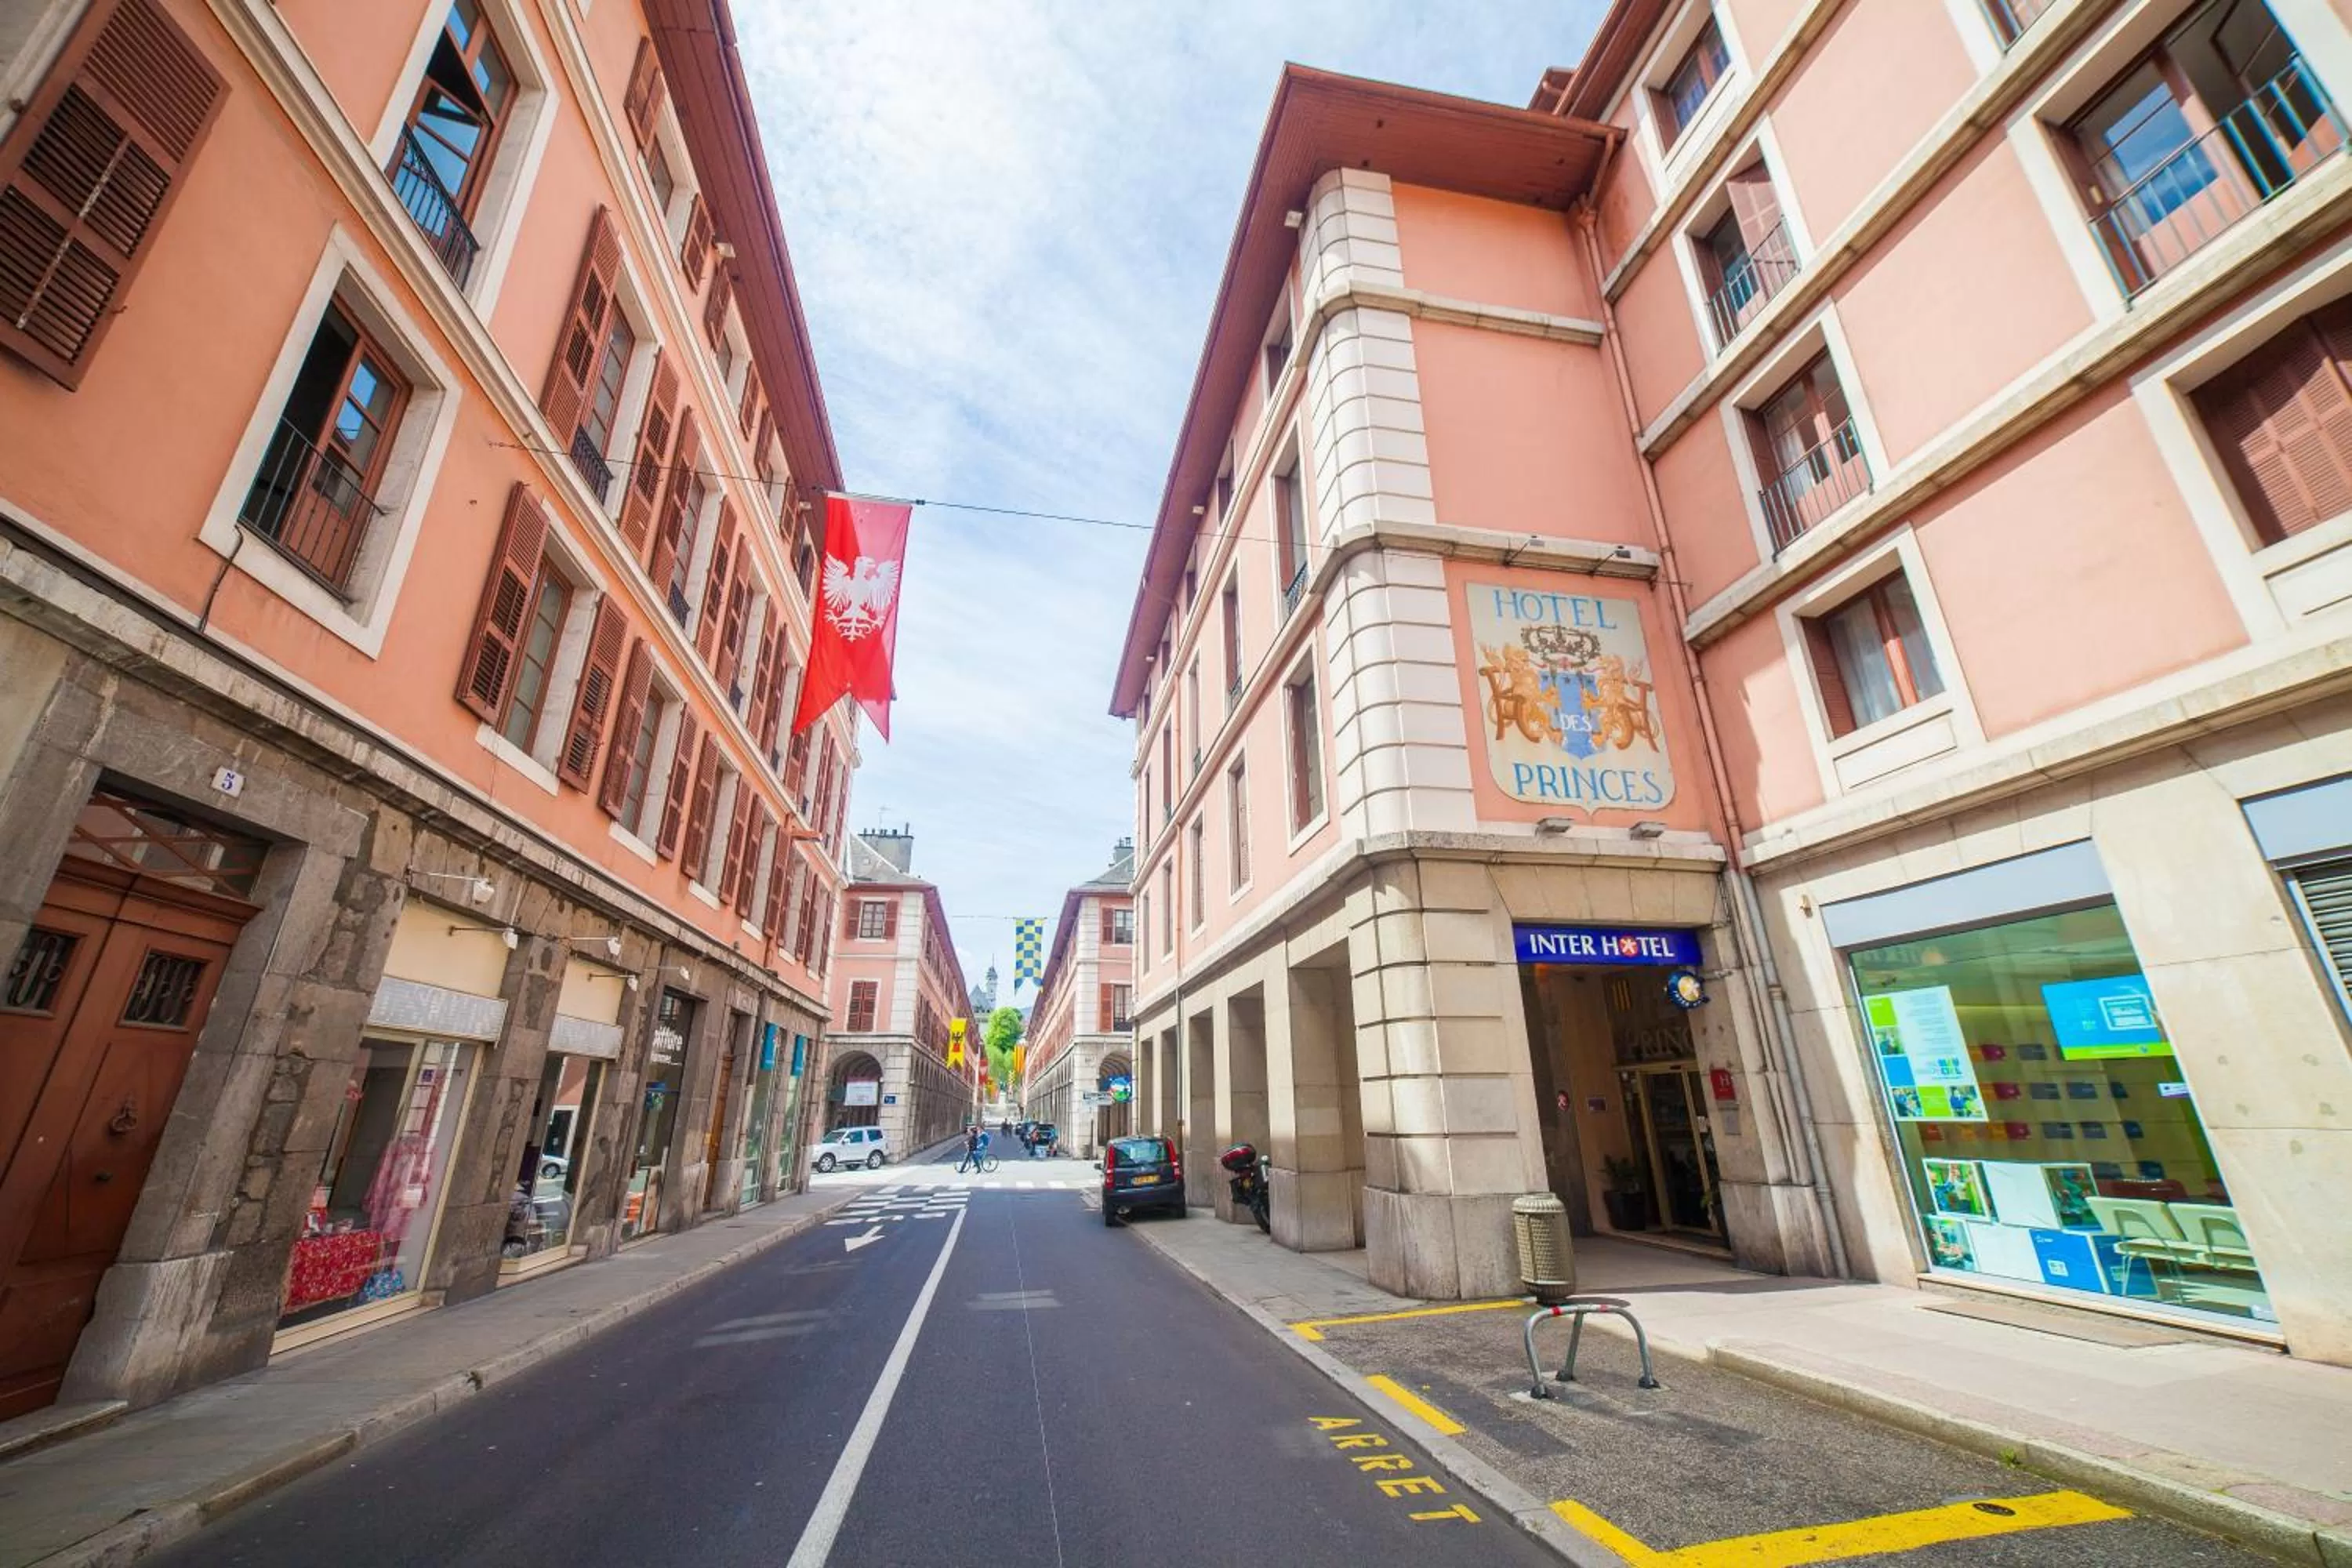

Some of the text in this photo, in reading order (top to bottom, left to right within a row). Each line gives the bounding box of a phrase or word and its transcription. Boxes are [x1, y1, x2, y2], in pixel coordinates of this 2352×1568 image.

[1493, 589, 1618, 629] HOTEL
[1559, 713, 1592, 732] DES
[1512, 762, 1664, 804] PRINCES
[1530, 934, 1596, 955] INTER
[1308, 1417, 1482, 1523] ARRET
